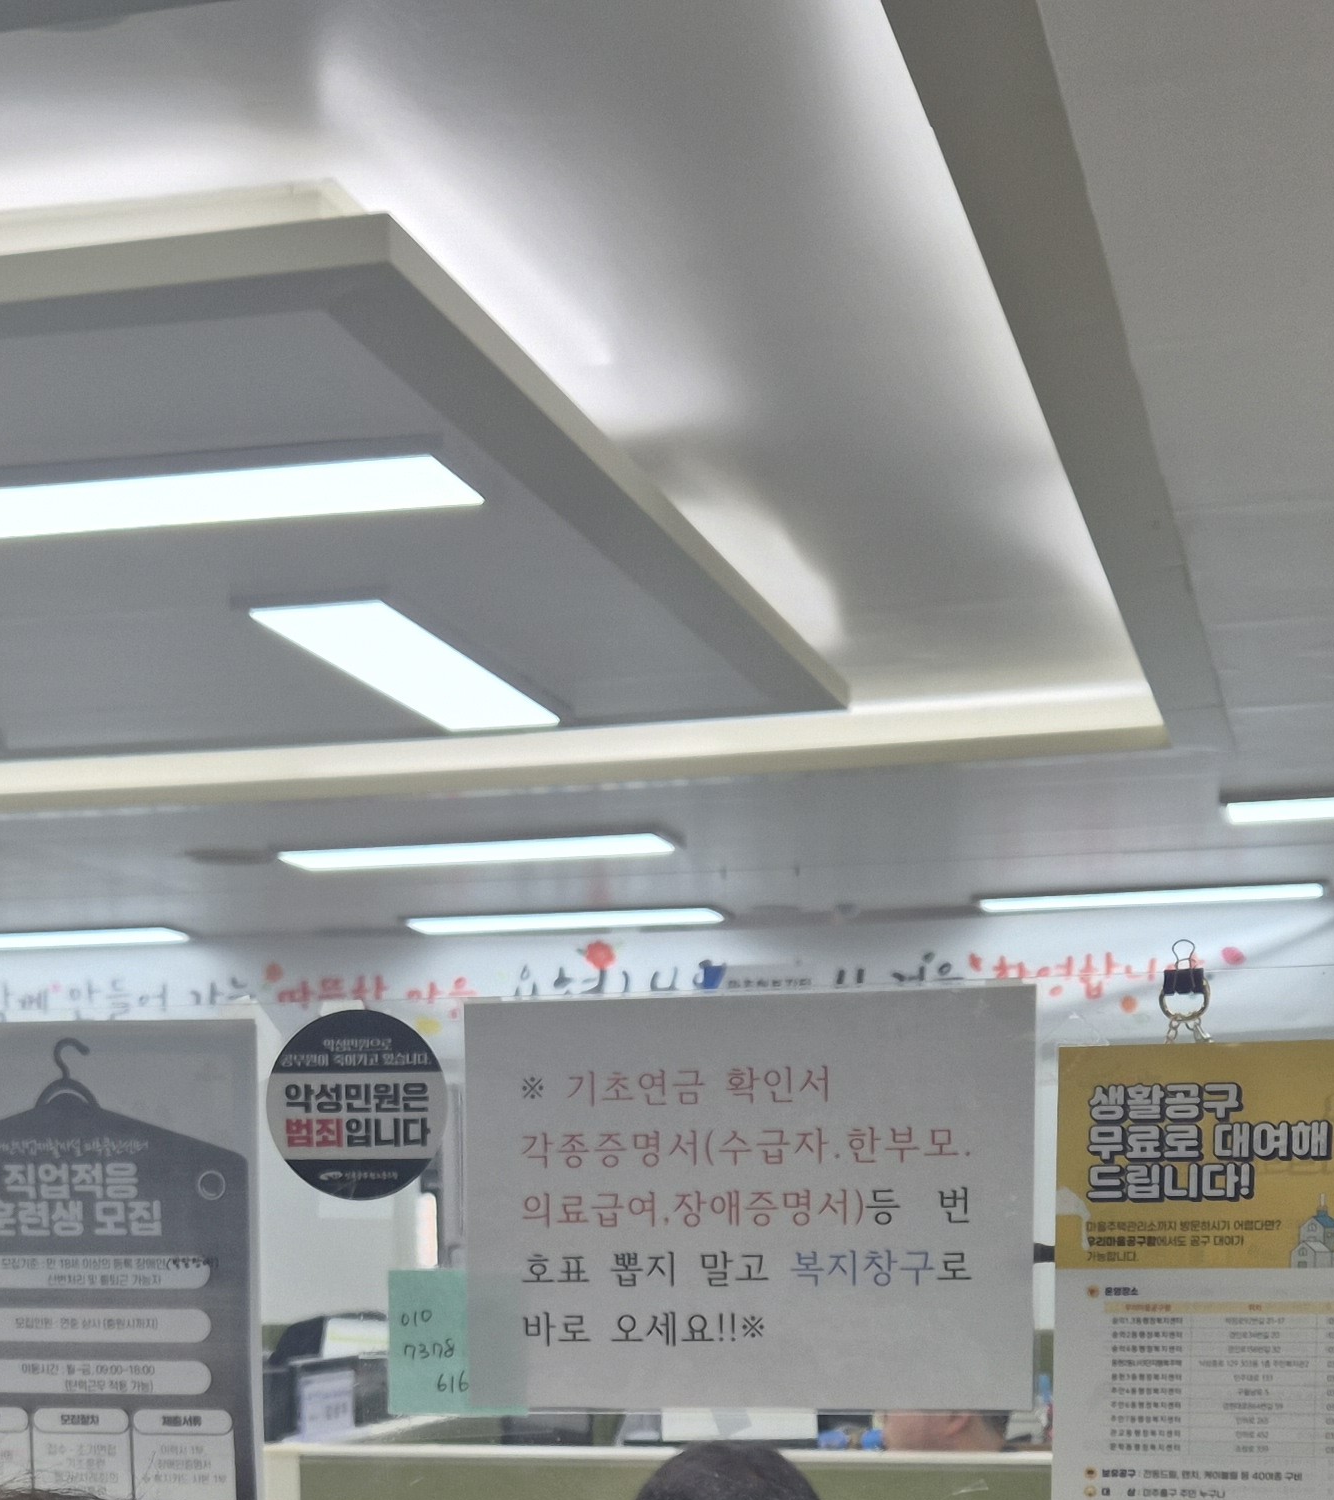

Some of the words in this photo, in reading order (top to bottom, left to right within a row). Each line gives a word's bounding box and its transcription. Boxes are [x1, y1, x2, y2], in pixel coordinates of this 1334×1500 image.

[285, 1082, 430, 1114] 악성민원은
[567, 1070, 705, 1106] 기초연금
[725, 1066, 831, 1103] 확인서
[1088, 1082, 1244, 1123] 생활공구
[285, 1117, 431, 1148] 범죄입니다
[1087, 1123, 1203, 1162] 무료로
[1213, 1120, 1333, 1161] 대여해
[4, 1162, 138, 1200] 직업적응
[1087, 1163, 1255, 1203] 드립니다!
[94, 1201, 162, 1236] 모집
[939, 1187, 971, 1226] 번
[522, 1254, 590, 1285] 호표
[610, 1251, 676, 1288] 뽑지
[700, 1252, 769, 1287] 말고
[790, 1250, 972, 1288] 복지창구로
[401, 1309, 433, 1327] 010
[522, 1313, 591, 1348] 바로
